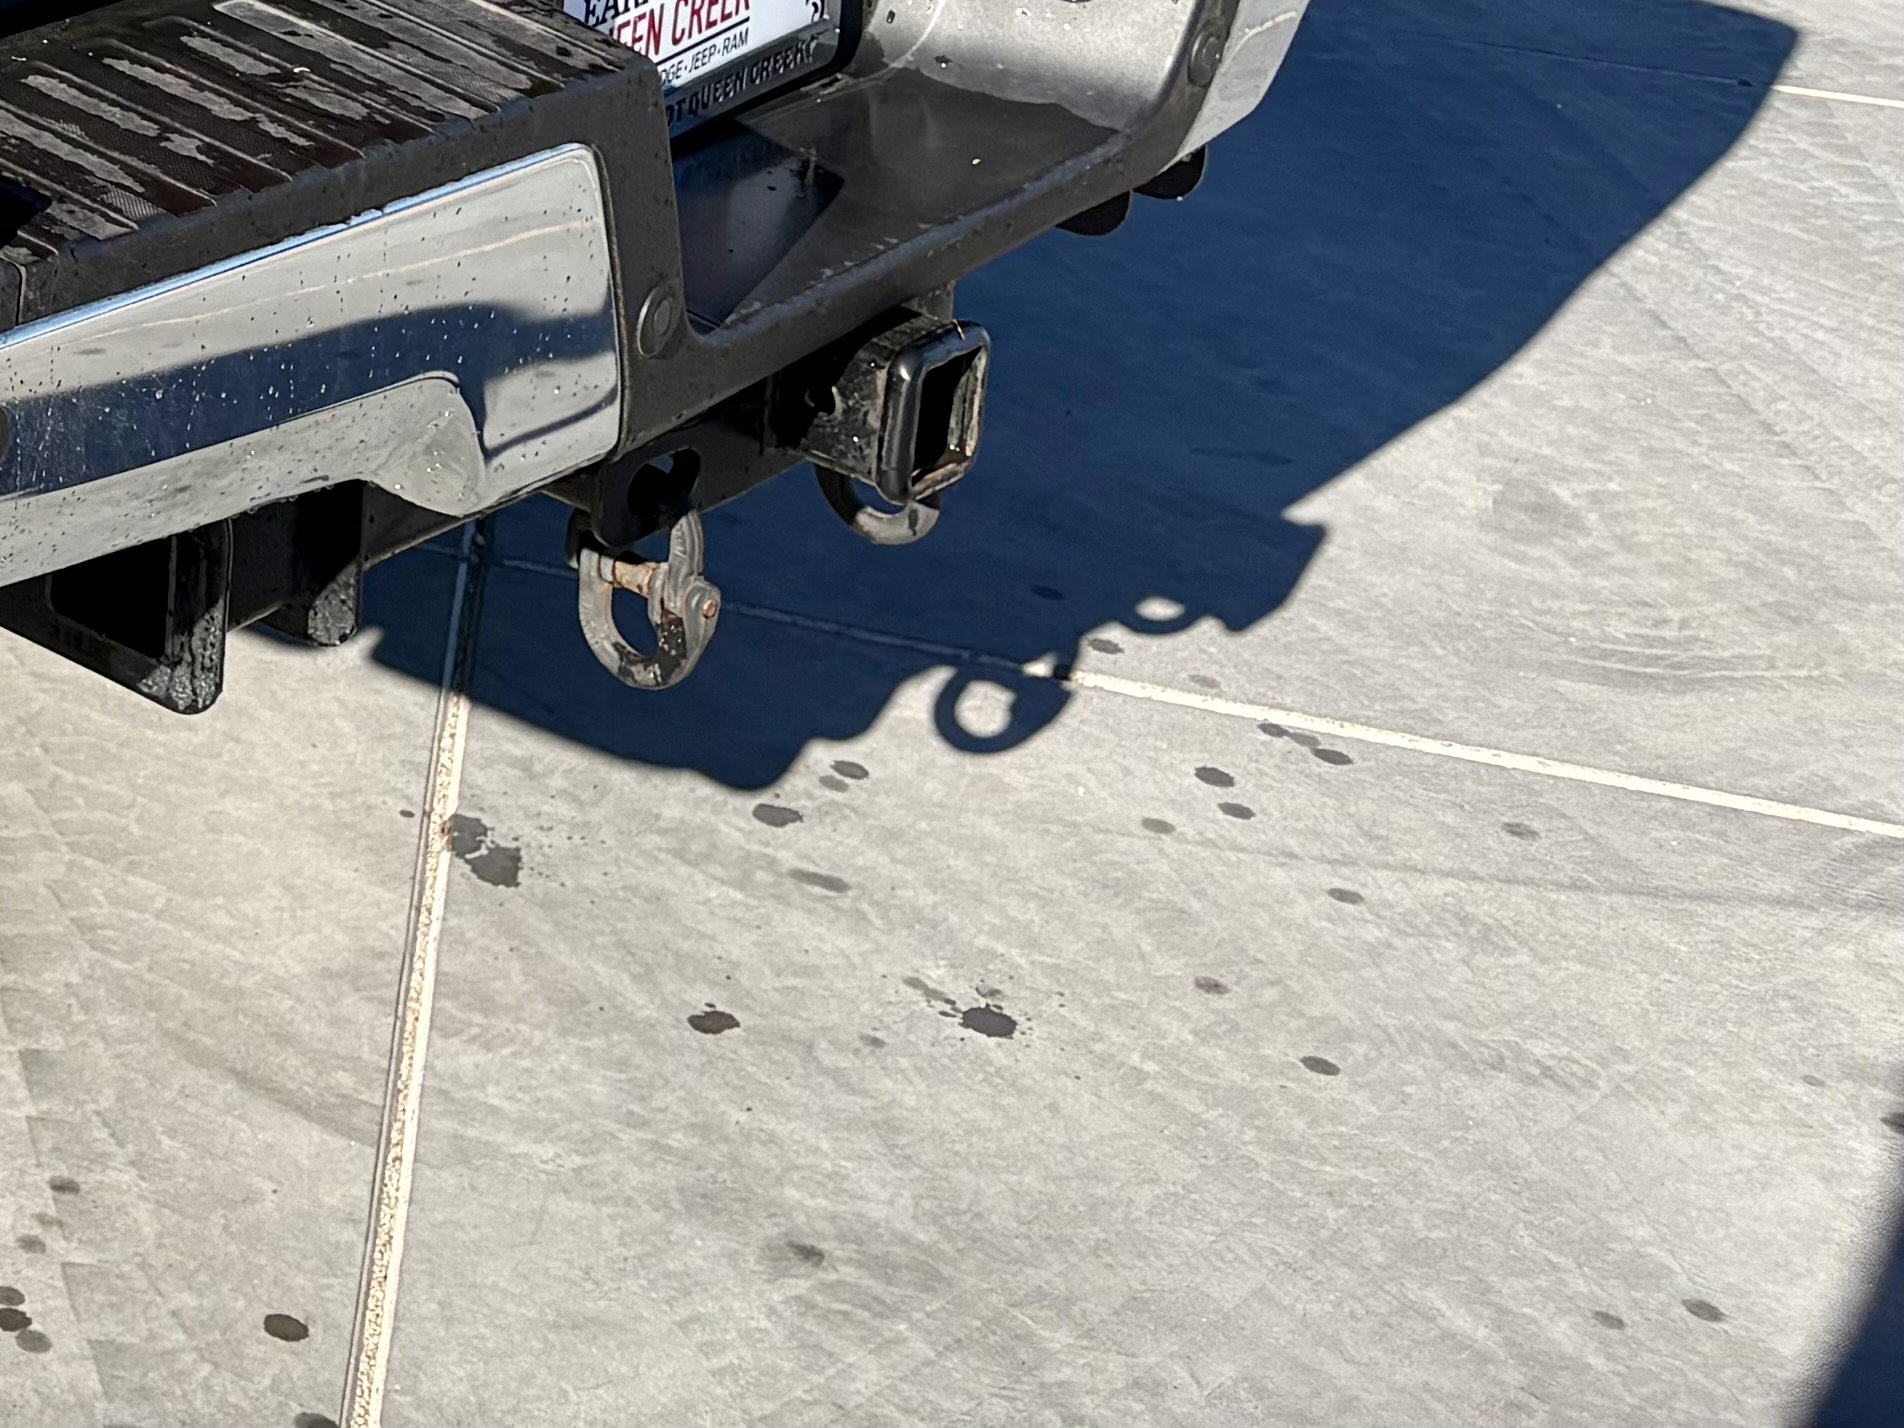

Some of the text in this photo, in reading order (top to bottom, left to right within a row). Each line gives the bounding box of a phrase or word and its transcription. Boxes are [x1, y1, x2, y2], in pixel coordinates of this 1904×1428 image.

[688, 45, 717, 74] JEEP
[722, 27, 750, 58] RAM
[688, 66, 748, 119] QUEEN
